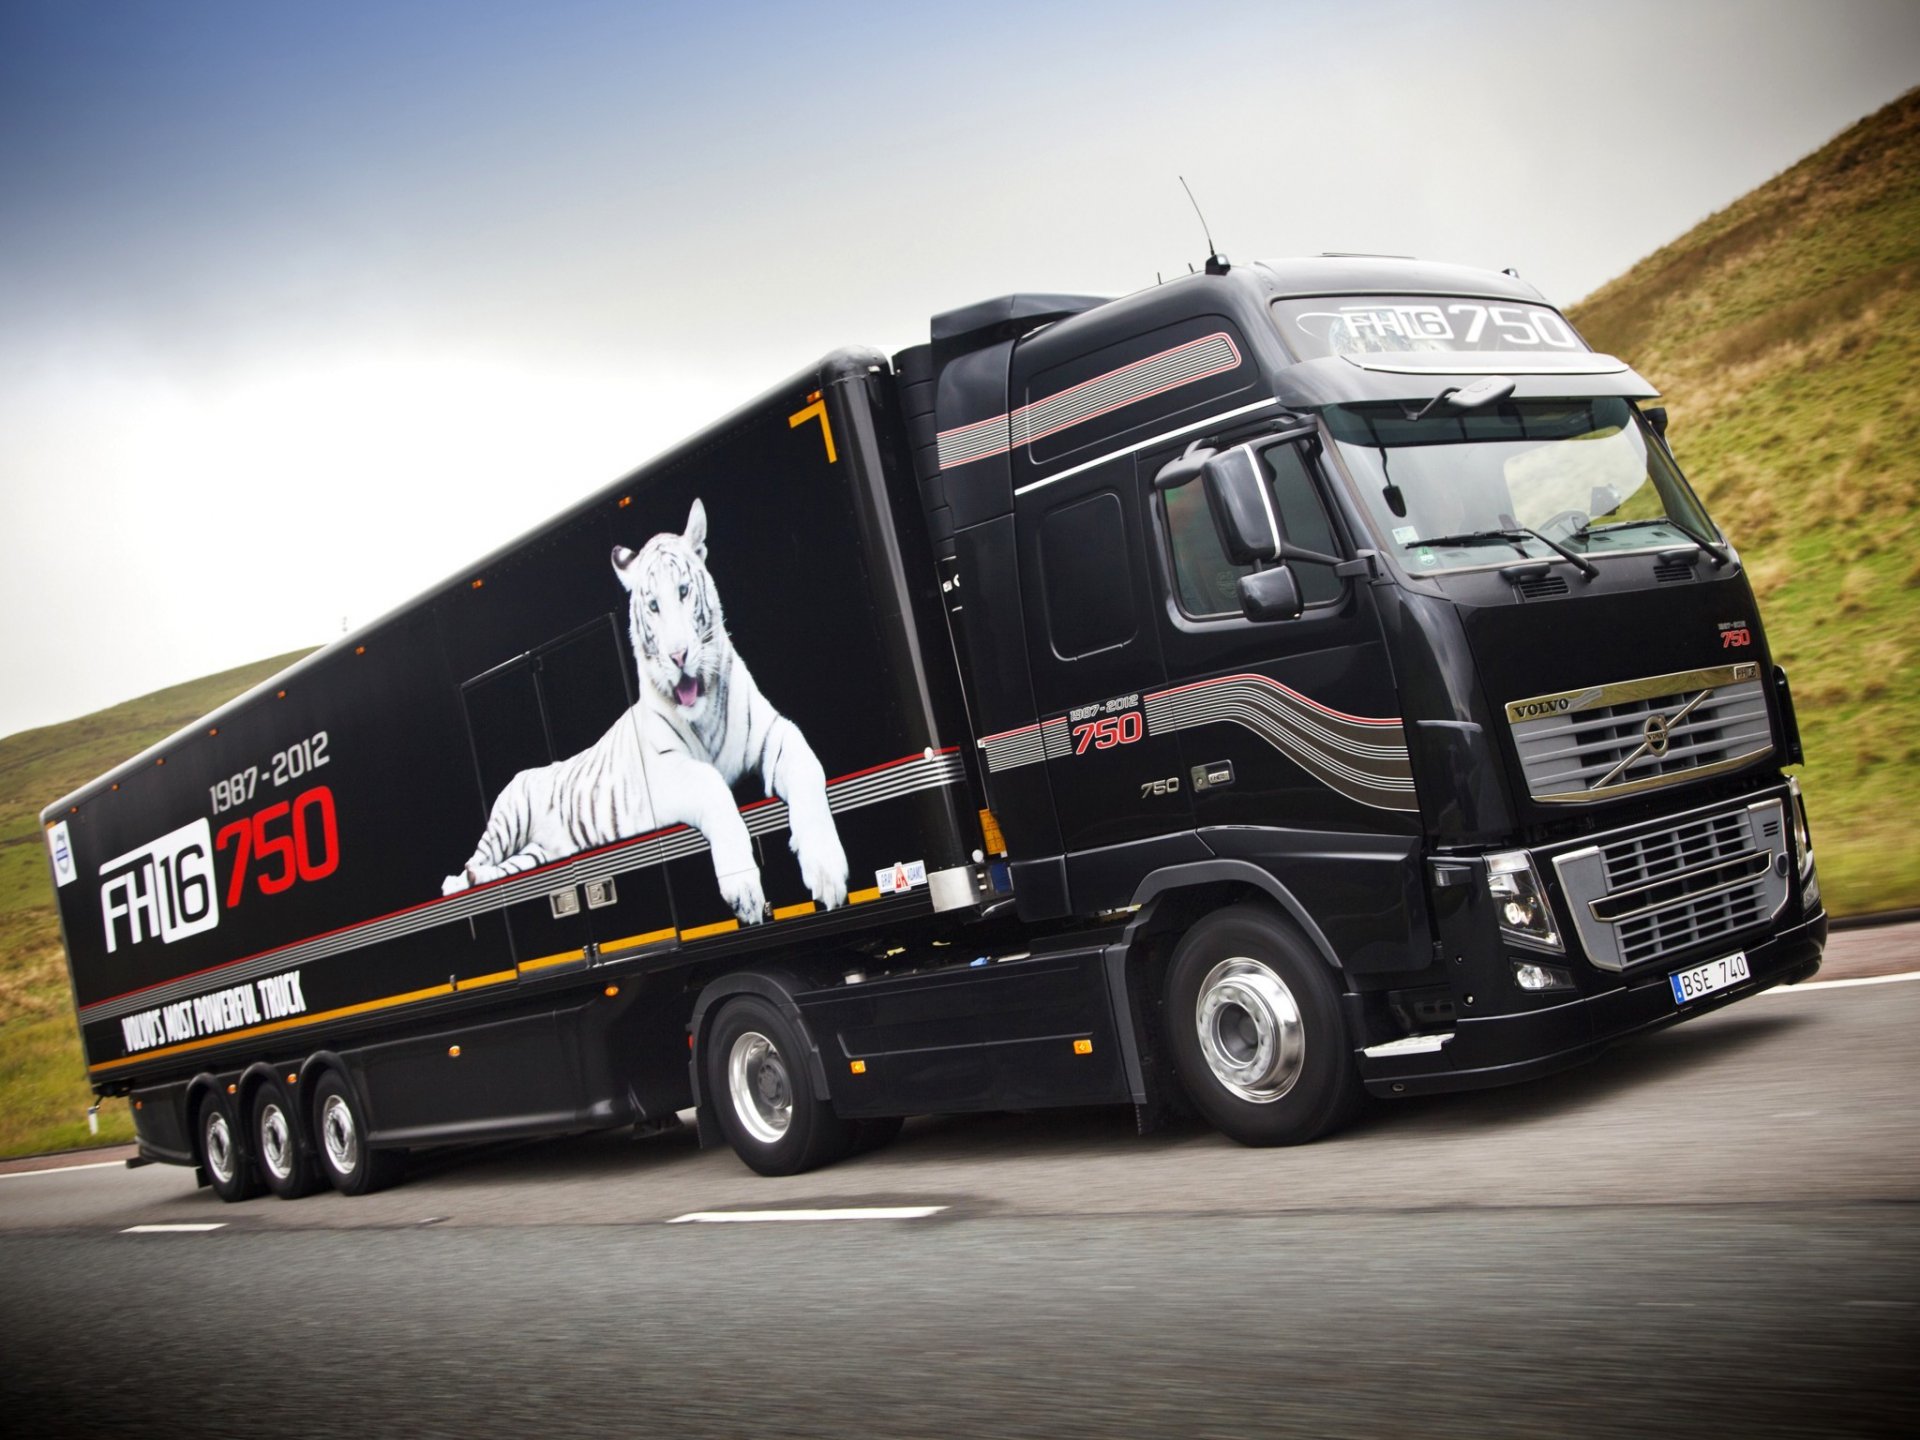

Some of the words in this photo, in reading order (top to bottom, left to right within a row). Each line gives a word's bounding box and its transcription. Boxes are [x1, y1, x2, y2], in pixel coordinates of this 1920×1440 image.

[1450, 304, 1575, 348] 750
[1720, 629, 1750, 648] 750
[1513, 698, 1569, 718] VOLVO
[1072, 711, 1143, 755] 750
[209, 731, 330, 815] 1987-2012
[1140, 777, 1179, 799] 750
[99, 817, 219, 953] FH16
[216, 786, 340, 908] 750
[1682, 968, 1713, 997] BSE
[1719, 956, 1746, 983] 740
[162, 999, 197, 1042] MOST
[193, 984, 261, 1036] POWERFUL
[257, 970, 307, 1020] TRUCK
